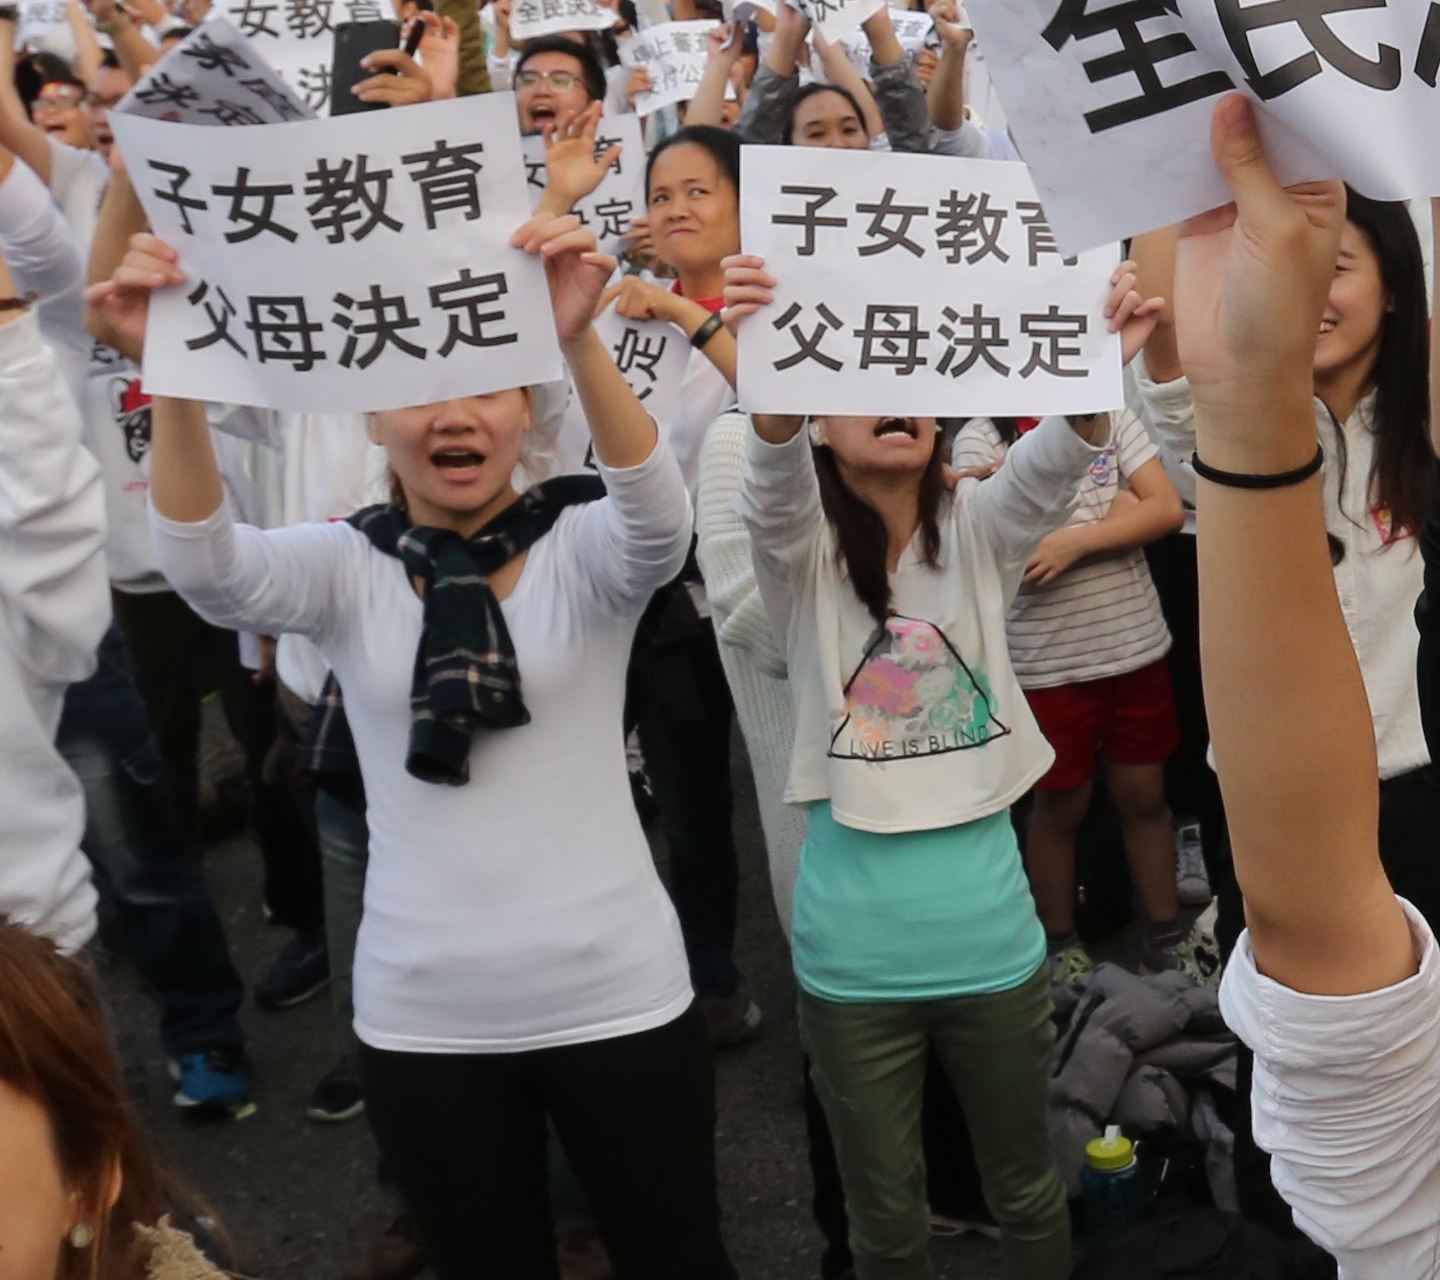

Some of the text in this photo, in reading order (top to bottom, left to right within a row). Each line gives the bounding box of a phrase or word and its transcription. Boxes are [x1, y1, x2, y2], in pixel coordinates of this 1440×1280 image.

[148, 138, 486, 245] 子女教育
[185, 268, 520, 374] 父母決定
[770, 303, 1090, 379] 父母決定
[902, 739, 920, 756] IS
[928, 724, 990, 753] BLIND
